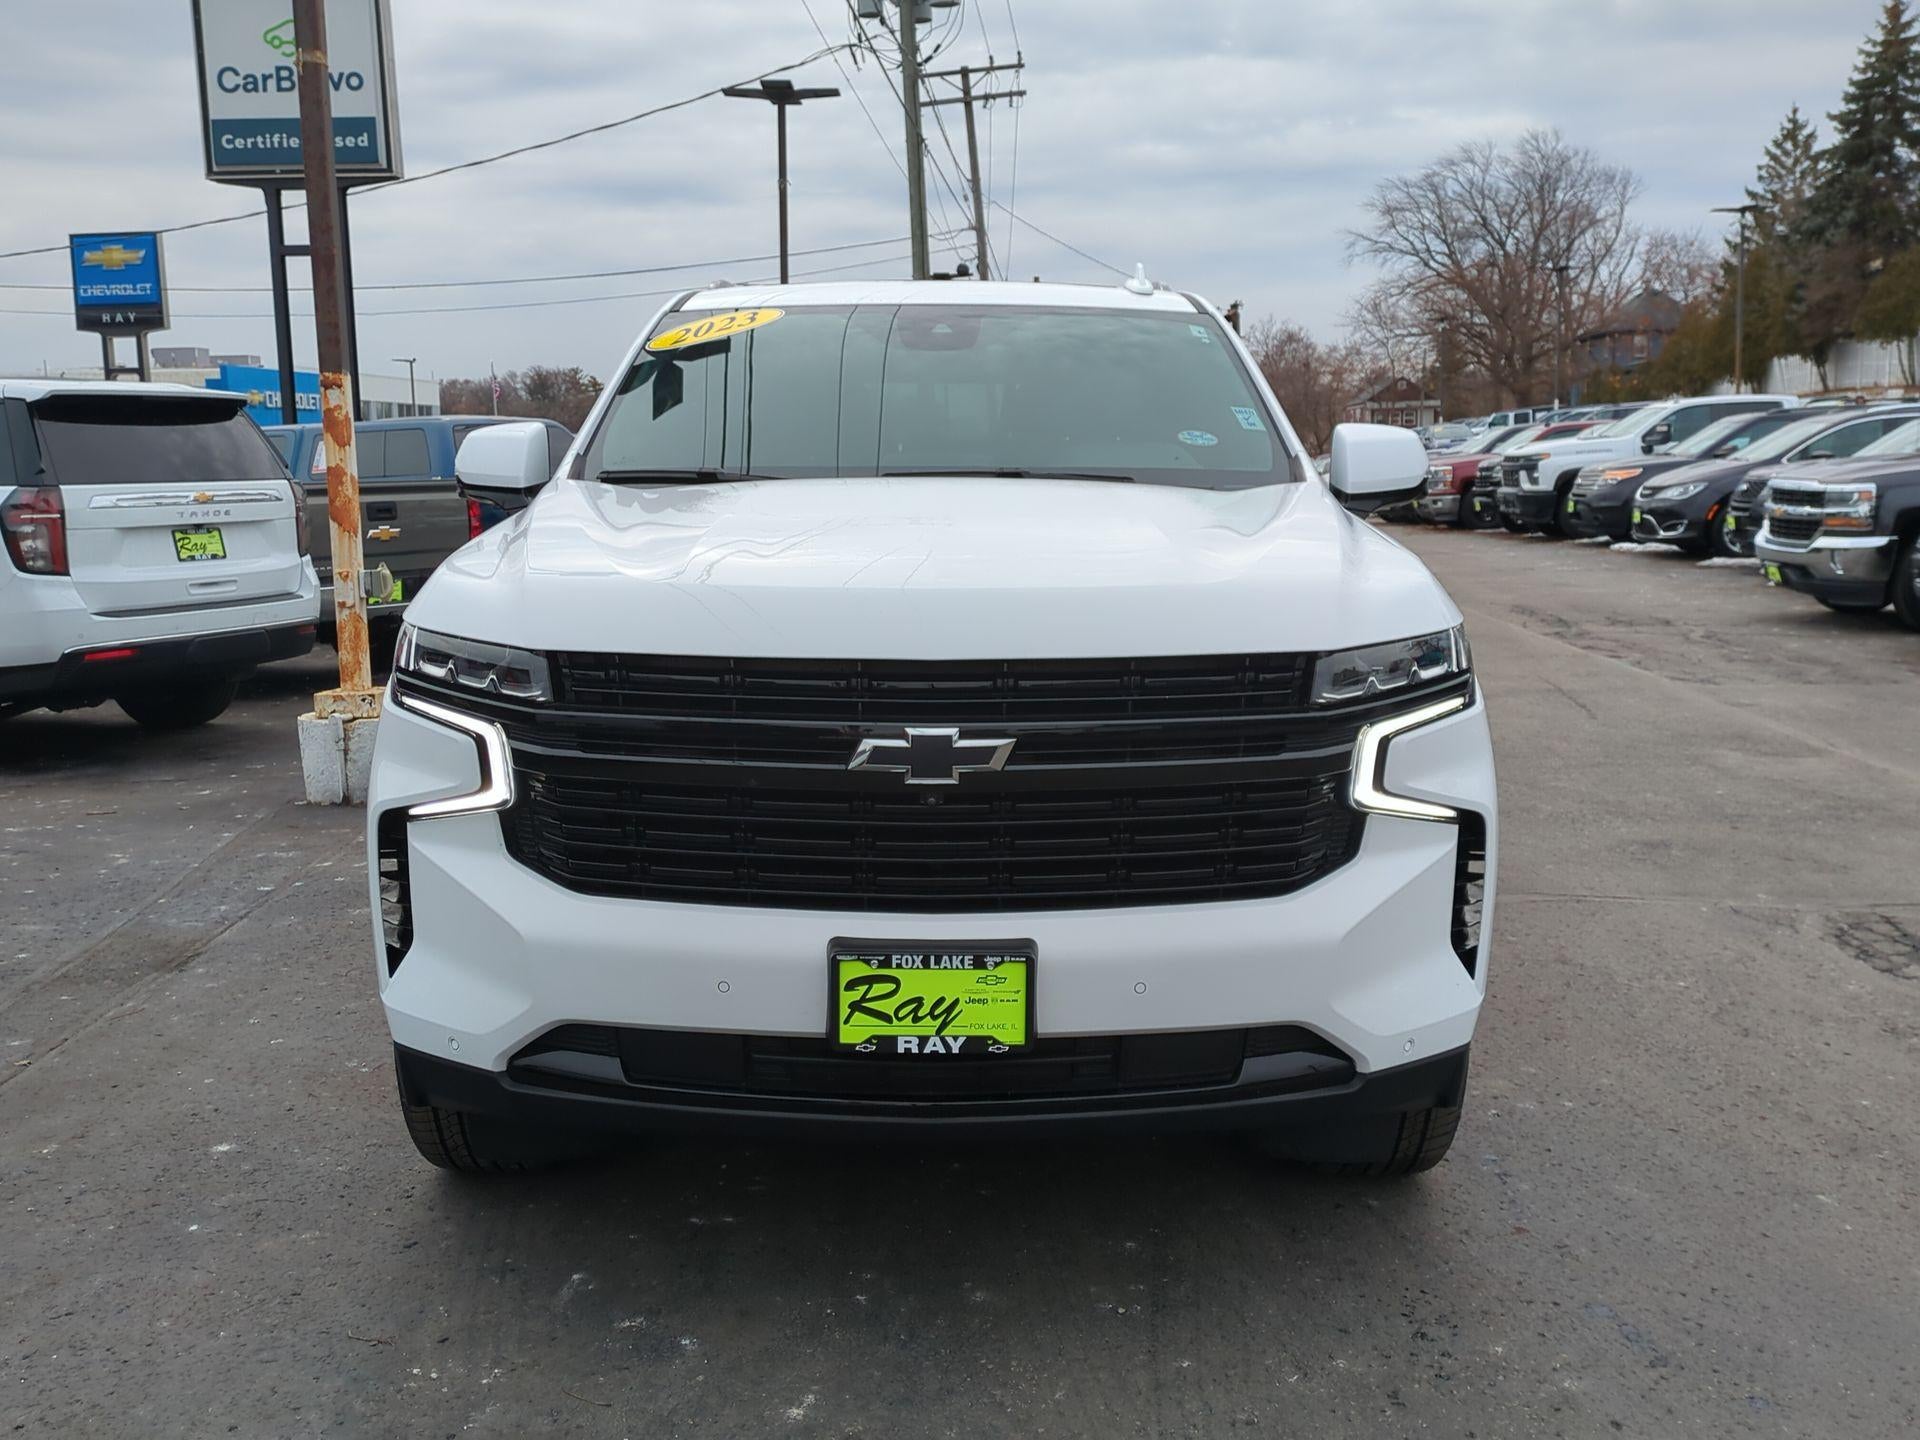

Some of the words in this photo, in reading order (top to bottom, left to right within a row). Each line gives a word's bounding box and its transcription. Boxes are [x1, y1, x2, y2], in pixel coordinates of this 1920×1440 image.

[217, 65, 364, 93] CarBvo
[221, 133, 300, 149] Certifie
[334, 132, 369, 148] sed
[80, 283, 152, 297] CHEVROLET
[102, 312, 136, 323] RAY
[669, 311, 759, 346] 2023
[265, 391, 320, 410] CHOLET
[176, 509, 231, 518] TAHOE
[177, 536, 208, 554] Ray
[891, 954, 924, 969] FOX
[930, 954, 974, 969] LAKE
[984, 955, 1002, 963] Jeep
[843, 973, 964, 1036] Ray
[964, 996, 989, 1006] Jeep
[987, 1023, 1009, 1031] LAKE,
[897, 1036, 968, 1054] RAY
